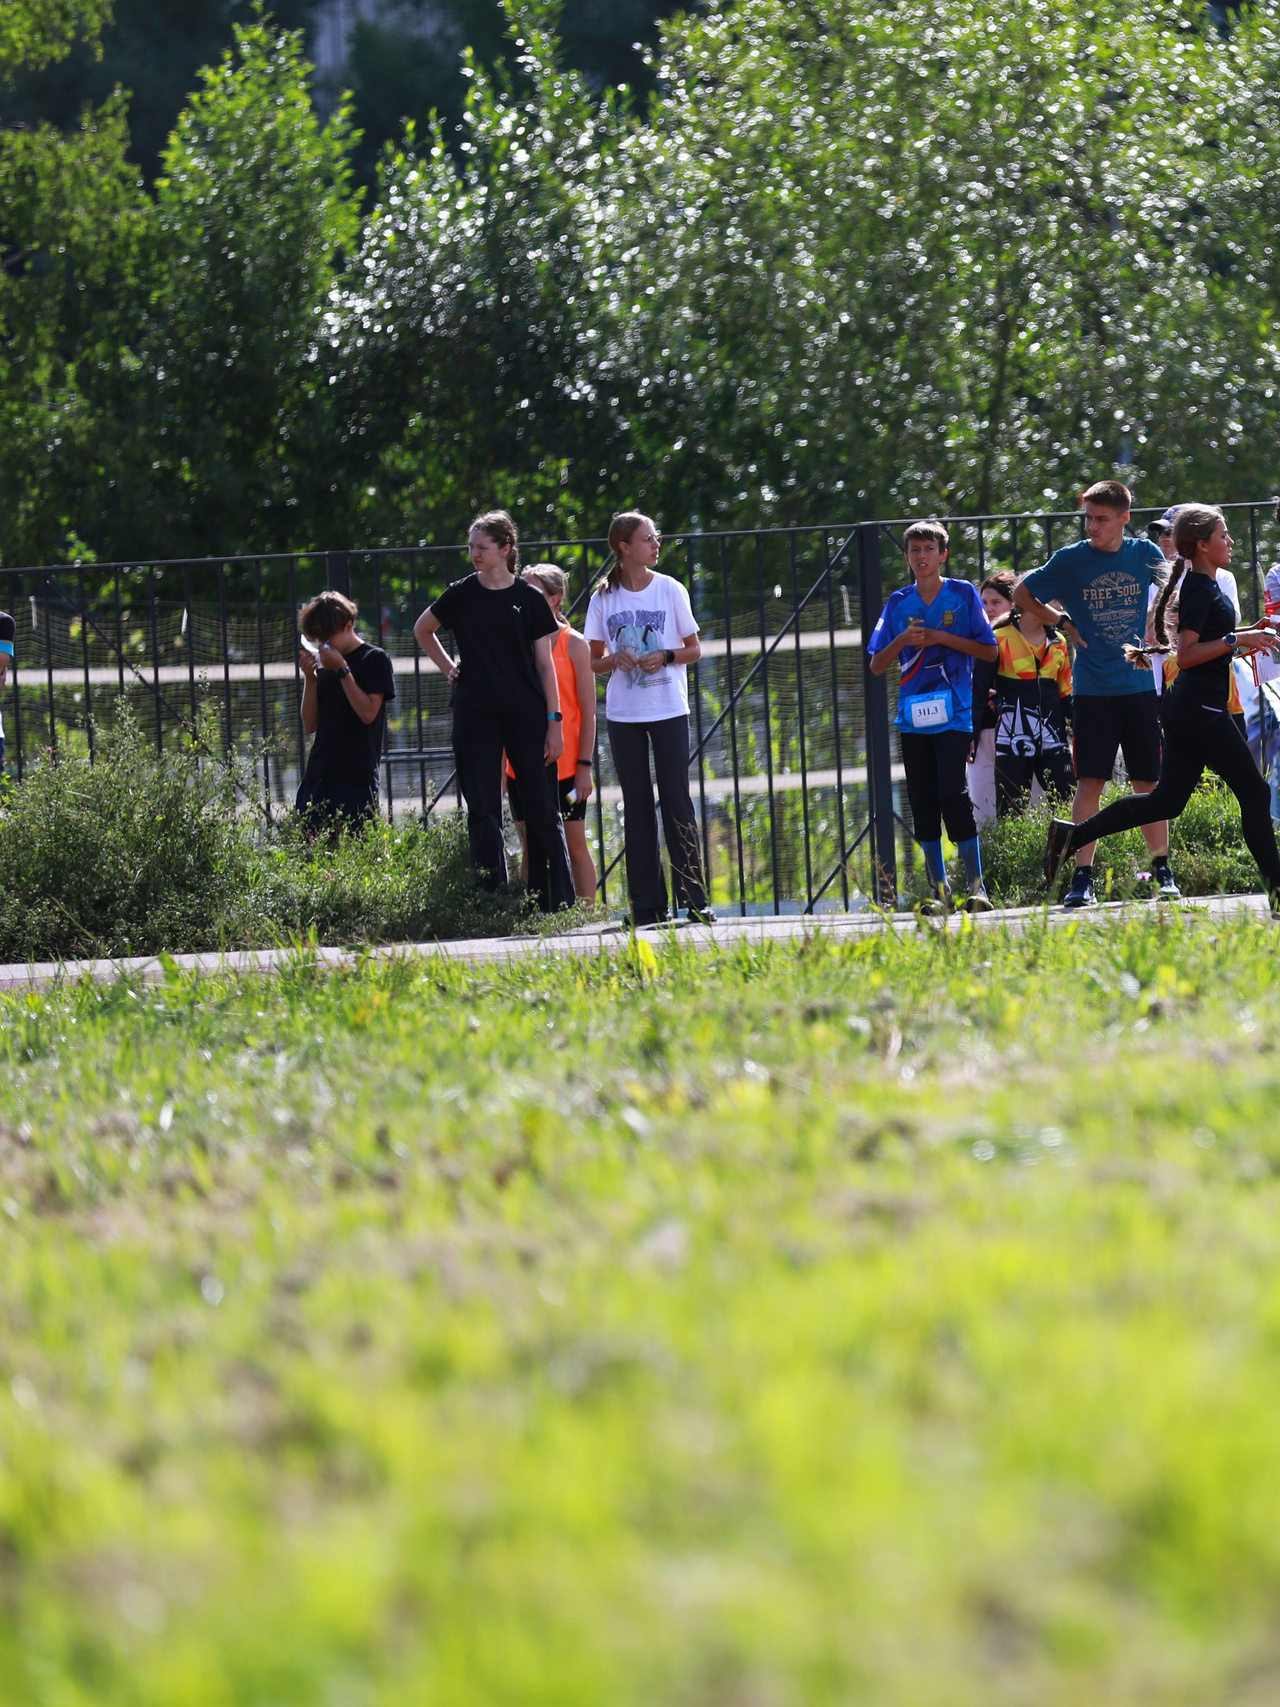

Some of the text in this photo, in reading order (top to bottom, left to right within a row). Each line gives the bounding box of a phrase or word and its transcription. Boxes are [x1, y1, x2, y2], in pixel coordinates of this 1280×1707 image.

[1083, 583, 1142, 600] FREE SOUL
[1095, 597, 1132, 609] 18 65
[918, 706, 938, 717] 311.3
